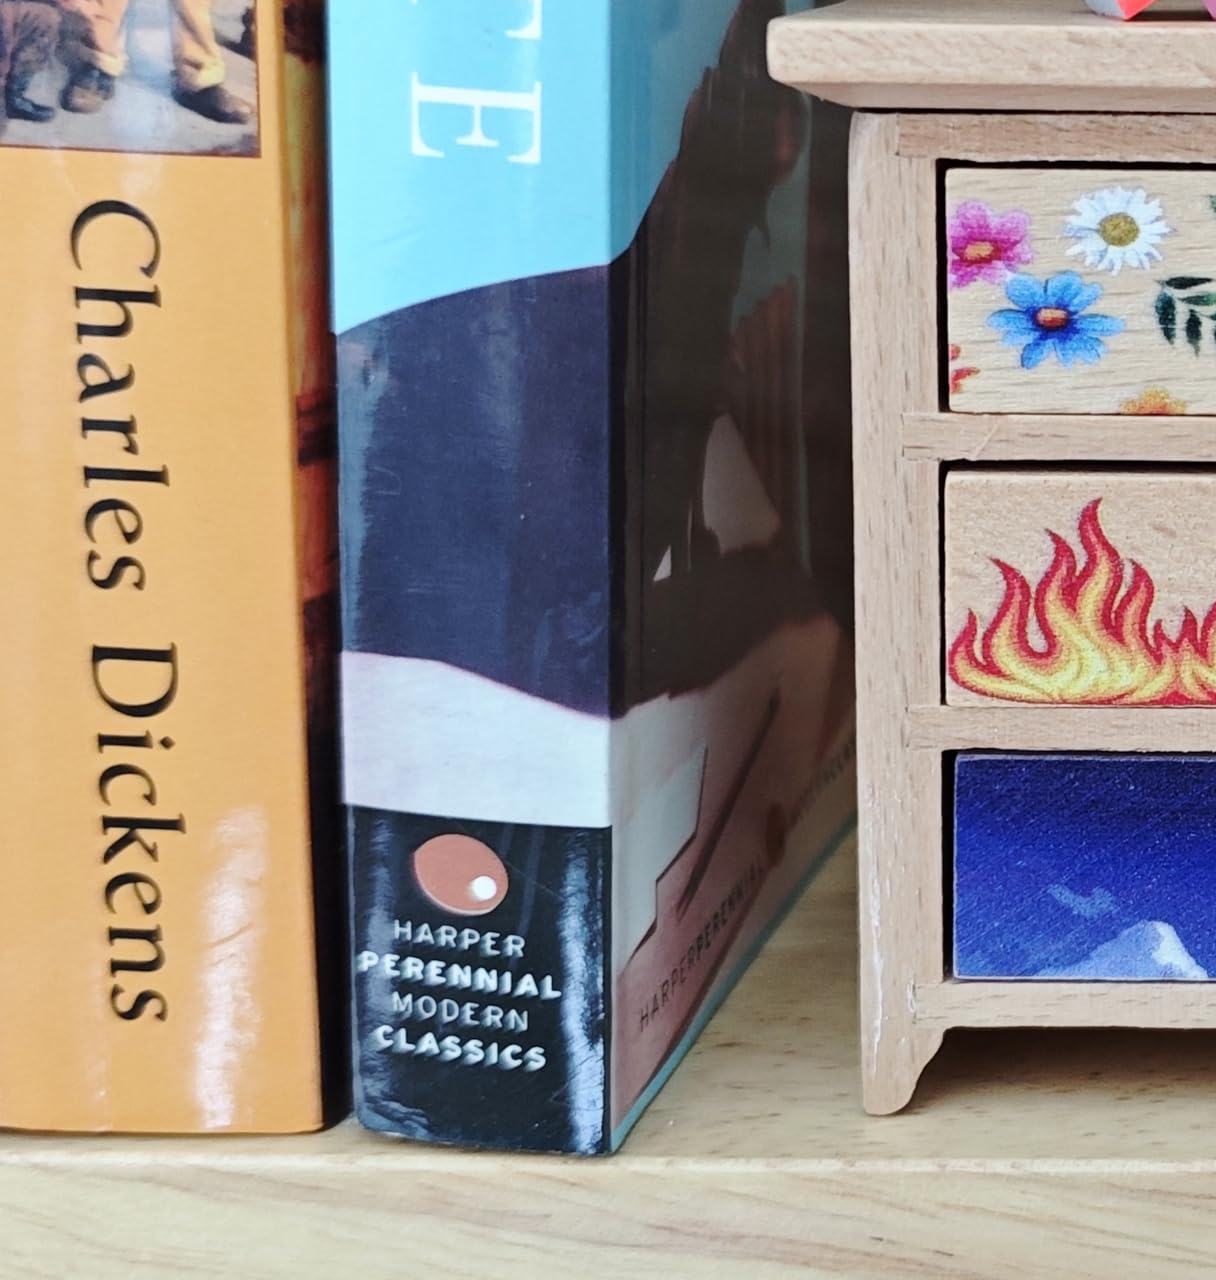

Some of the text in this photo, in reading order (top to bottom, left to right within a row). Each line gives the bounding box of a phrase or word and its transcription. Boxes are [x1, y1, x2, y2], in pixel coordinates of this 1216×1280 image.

[69, 199, 187, 1026] Charles Dickens
[393, 918, 526, 960] HARPER
[355, 950, 562, 1000] PERENNIAL
[391, 990, 529, 1032] MODERN
[373, 1024, 547, 1072] CLASSICS
